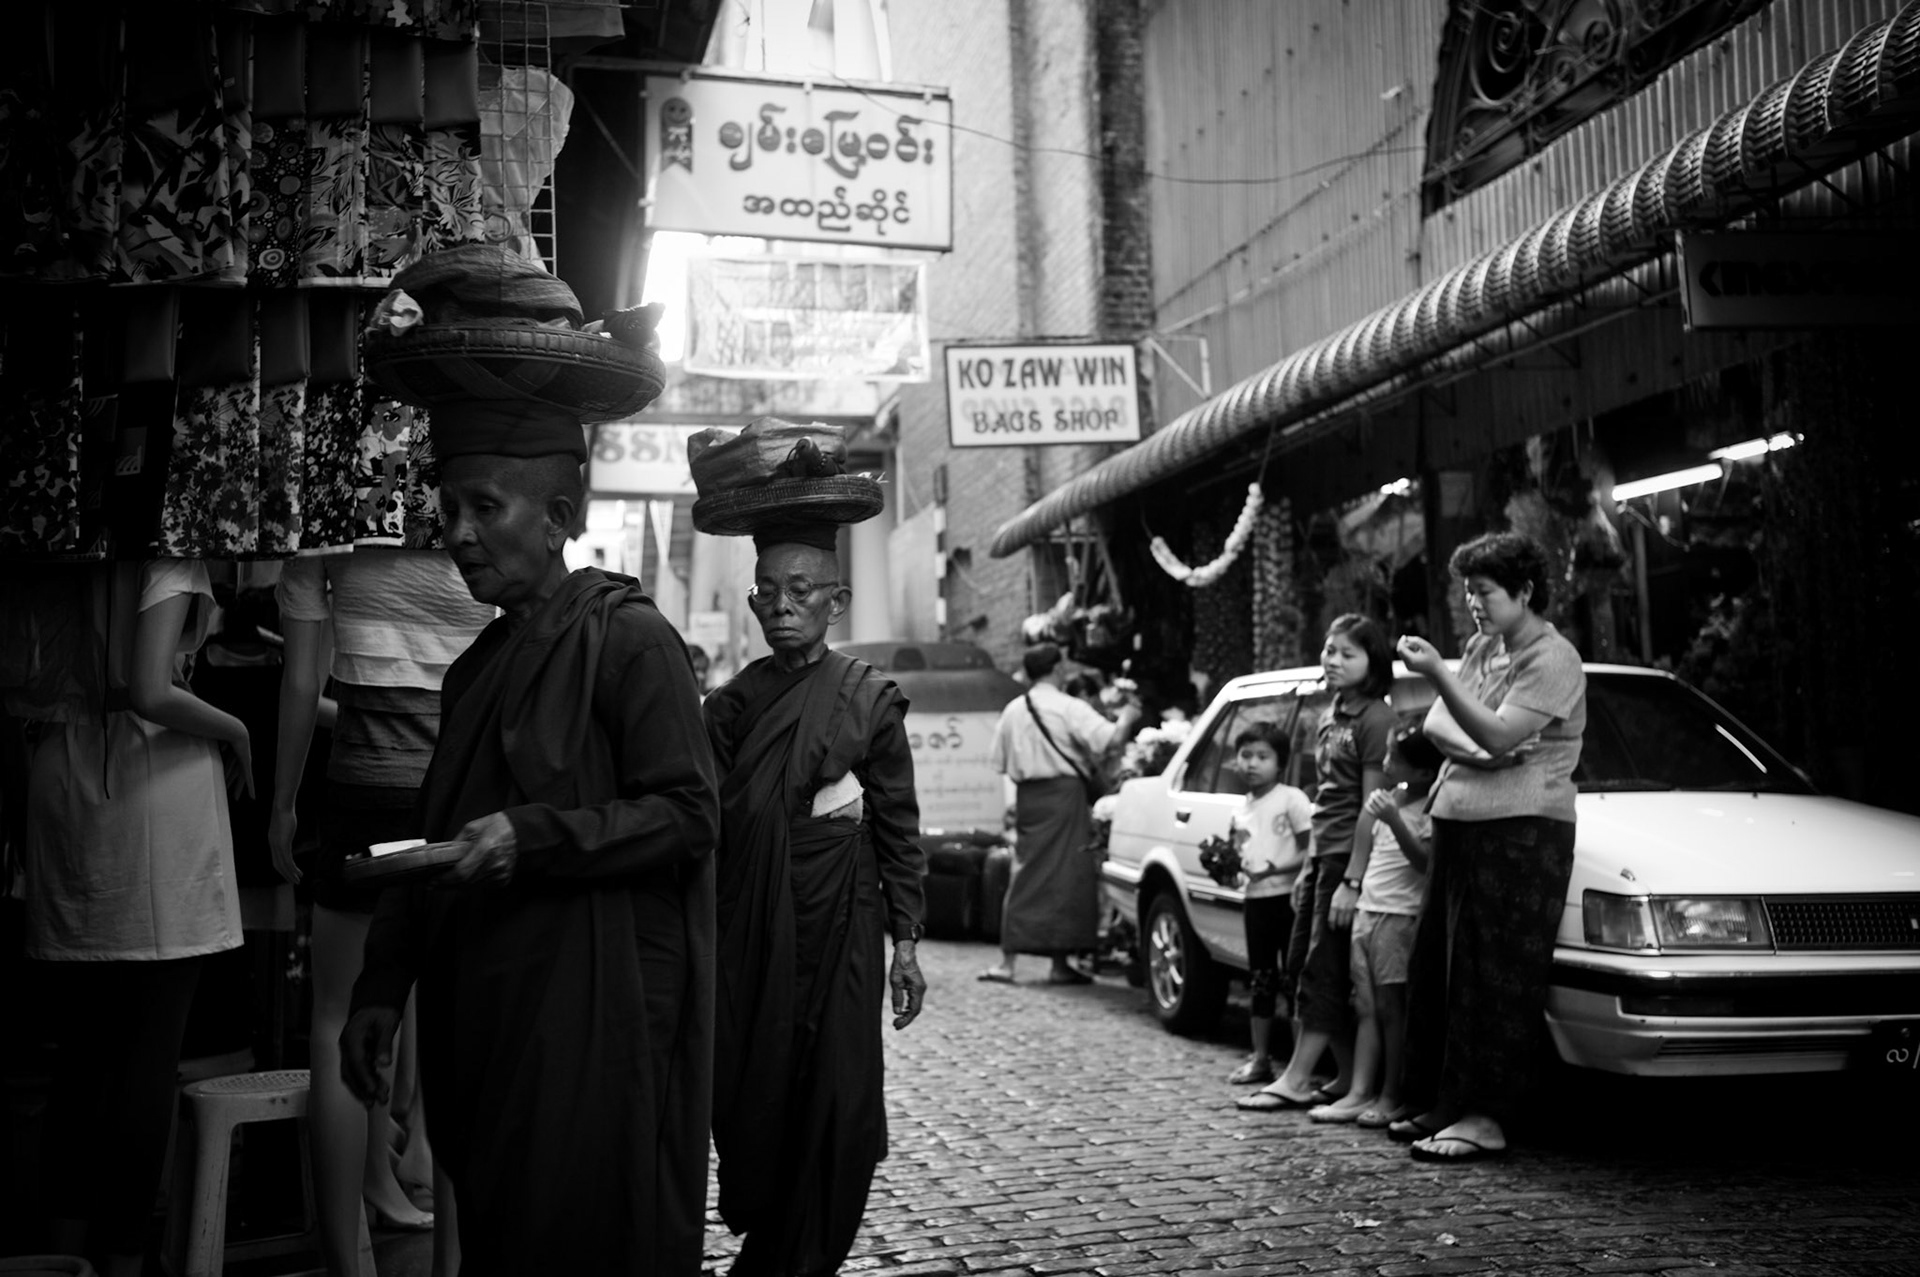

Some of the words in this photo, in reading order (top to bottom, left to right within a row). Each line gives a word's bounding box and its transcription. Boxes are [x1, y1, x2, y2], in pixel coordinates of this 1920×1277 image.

[743, 187, 911, 235] အထည်ဆိုင်
[958, 359, 994, 388] KO
[1003, 358, 1063, 388] ZAW
[1074, 357, 1126, 386] WIN
[972, 410, 1042, 434] BAGS
[1055, 409, 1119, 431] SHOP
